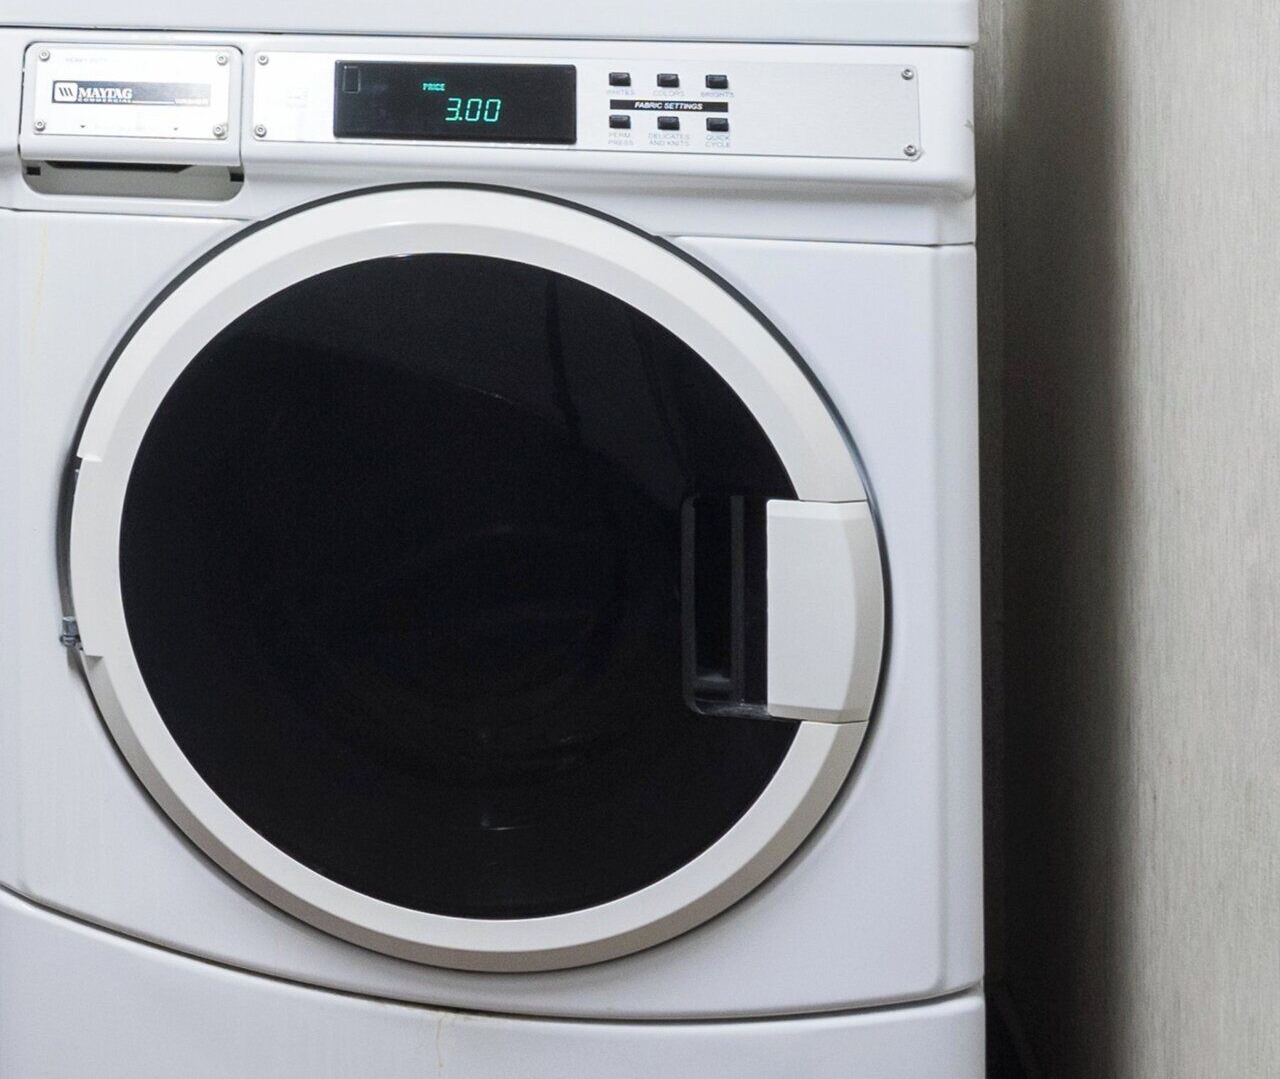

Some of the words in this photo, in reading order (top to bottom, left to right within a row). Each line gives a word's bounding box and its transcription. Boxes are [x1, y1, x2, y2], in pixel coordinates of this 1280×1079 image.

[422, 83, 445, 91] PRICE
[78, 87, 133, 99] MAYTAG
[445, 97, 501, 122] 3.00
[664, 102, 703, 110] SETTINGS
